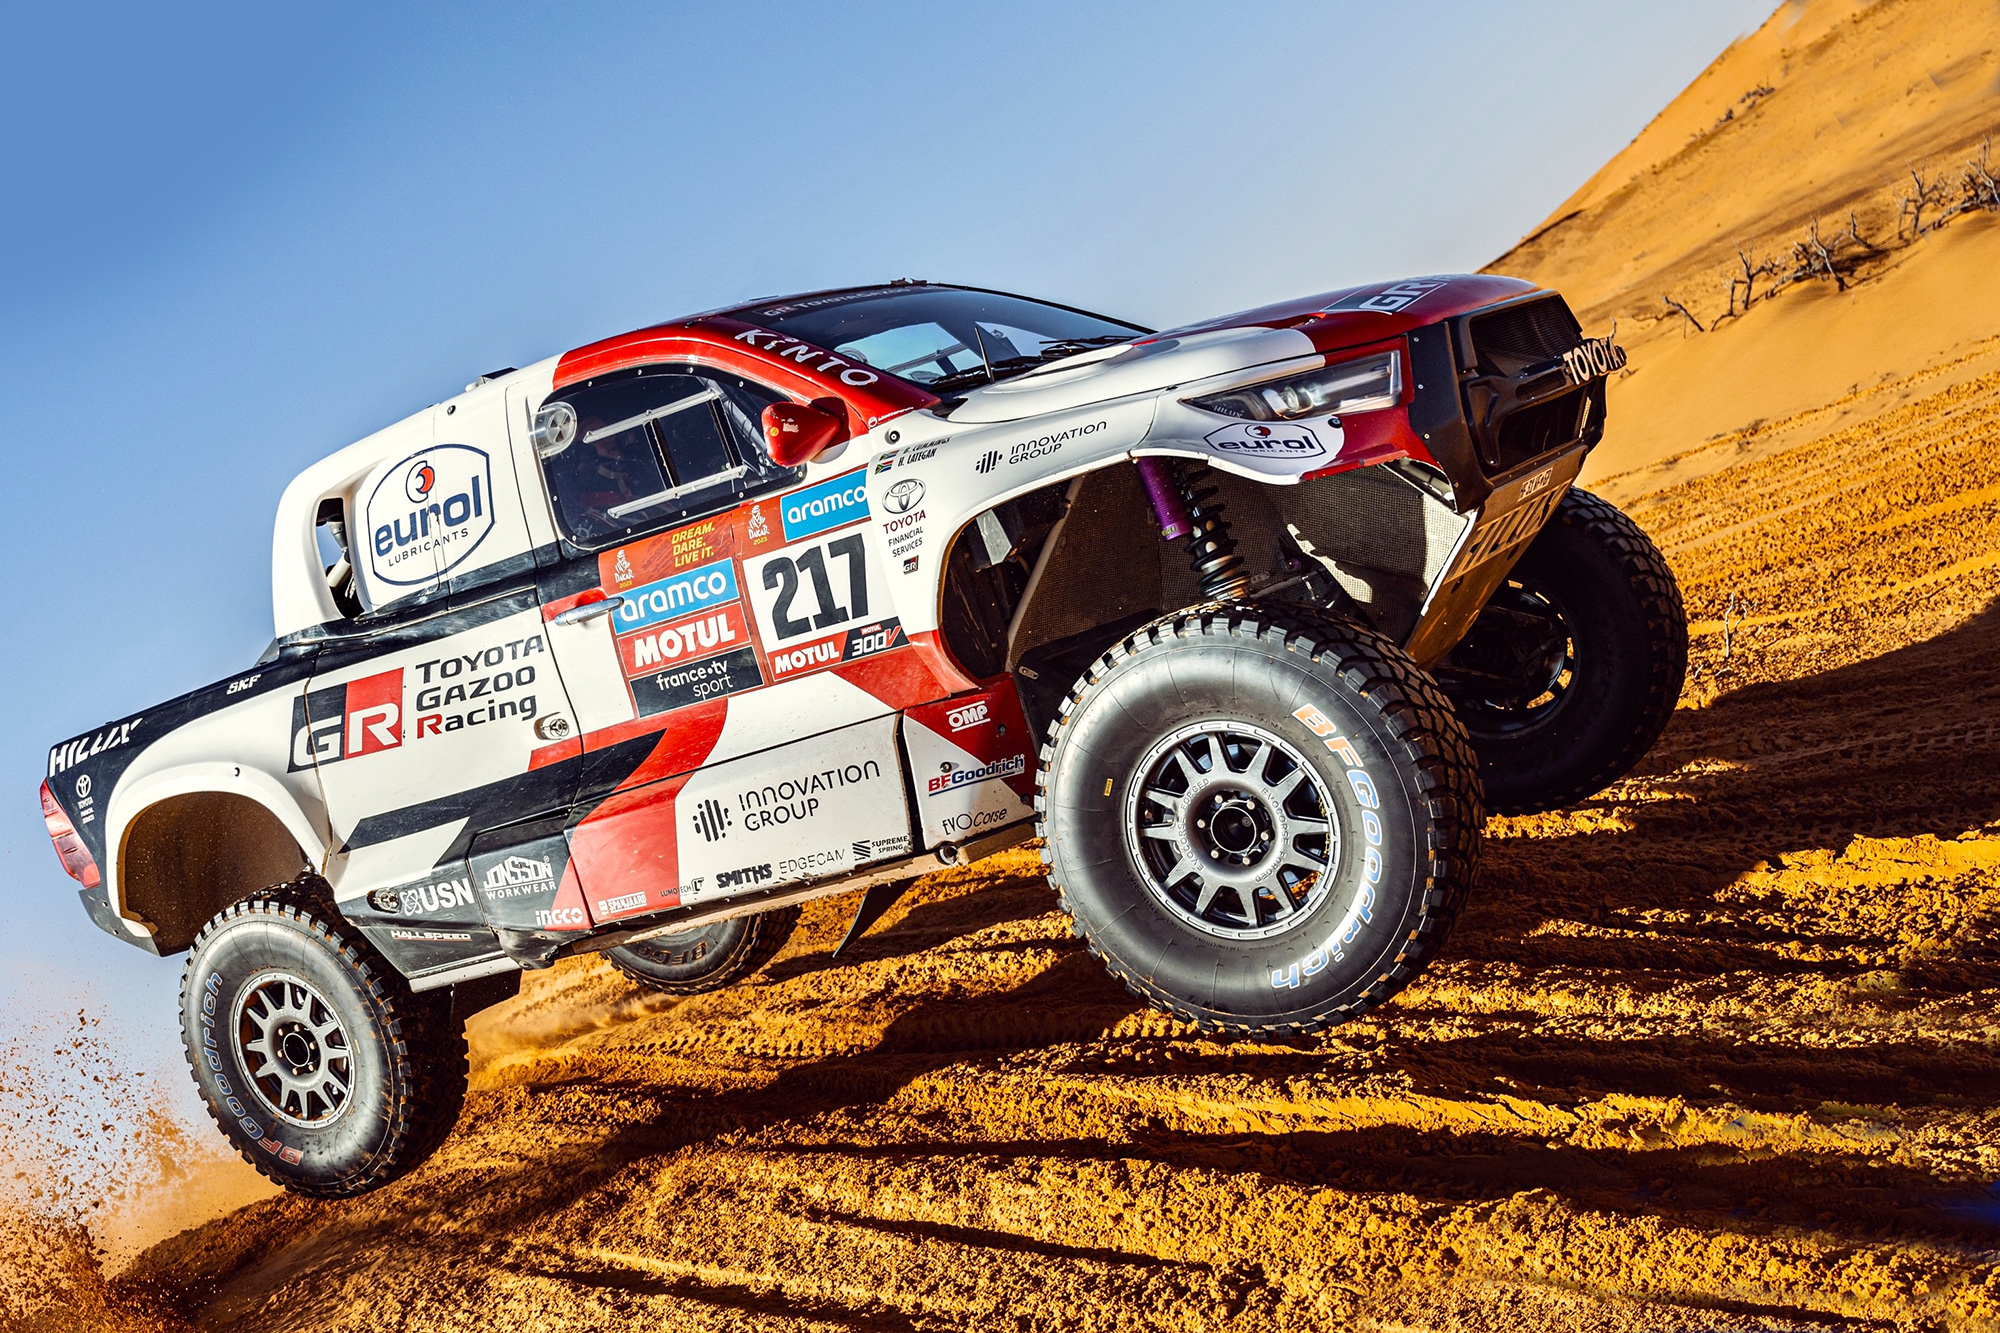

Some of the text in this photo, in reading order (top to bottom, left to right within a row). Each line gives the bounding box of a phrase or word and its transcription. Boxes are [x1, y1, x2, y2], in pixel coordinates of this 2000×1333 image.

[1562, 337, 1622, 386] TOYOTA
[1011, 421, 1107, 455] INNOVATION
[1218, 436, 1315, 450] eurol
[907, 448, 938, 465] LATEGAN
[1009, 443, 1062, 465] GROUP
[375, 475, 483, 557] eurol
[788, 486, 868, 523] aramco
[671, 522, 715, 545] DREAM.
[883, 509, 926, 534] TOYOTA
[888, 527, 924, 546] FINANCIAL
[388, 528, 469, 567] LUBRICANTS
[673, 538, 706, 556] DARE.
[753, 537, 767, 545] 2023
[892, 538, 923, 557] SERVICES
[674, 546, 715, 568] LIVE IT.
[619, 581, 633, 589] 2023
[620, 571, 727, 622] aramco
[762, 533, 869, 640] 217
[635, 613, 735, 668] MOTUL
[852, 626, 901, 657] 300V
[862, 624, 881, 635] MOTUL
[415, 634, 545, 684] TOYOTA
[775, 641, 840, 674] MOTUL
[226, 674, 261, 695] SKF
[416, 665, 536, 712] GAZOO
[693, 674, 734, 701] sport
[417, 695, 538, 740] Racing
[948, 704, 988, 728] OMP
[50, 718, 143, 777] HILUX
[294, 702, 399, 766] GR
[739, 760, 881, 812] INNOVATION
[929, 754, 1025, 792] BFGoodrich
[1182, 778, 1209, 811] FORGED
[744, 798, 819, 831] GROUP
[871, 835, 908, 848] SUPREME
[878, 844, 904, 854] SPRING
[1271, 703, 1383, 990] BFGoodrich
[483, 856, 553, 888] JONSSON
[716, 863, 773, 888] SMITHS
[779, 848, 845, 874] EDGECAM
[421, 878, 475, 912] USN
[486, 881, 557, 900] WORKWEAR
[608, 894, 647, 911] SPANJAARD
[391, 930, 472, 941] HALLSPEED
[201, 972, 304, 1166] BFGoodrich
